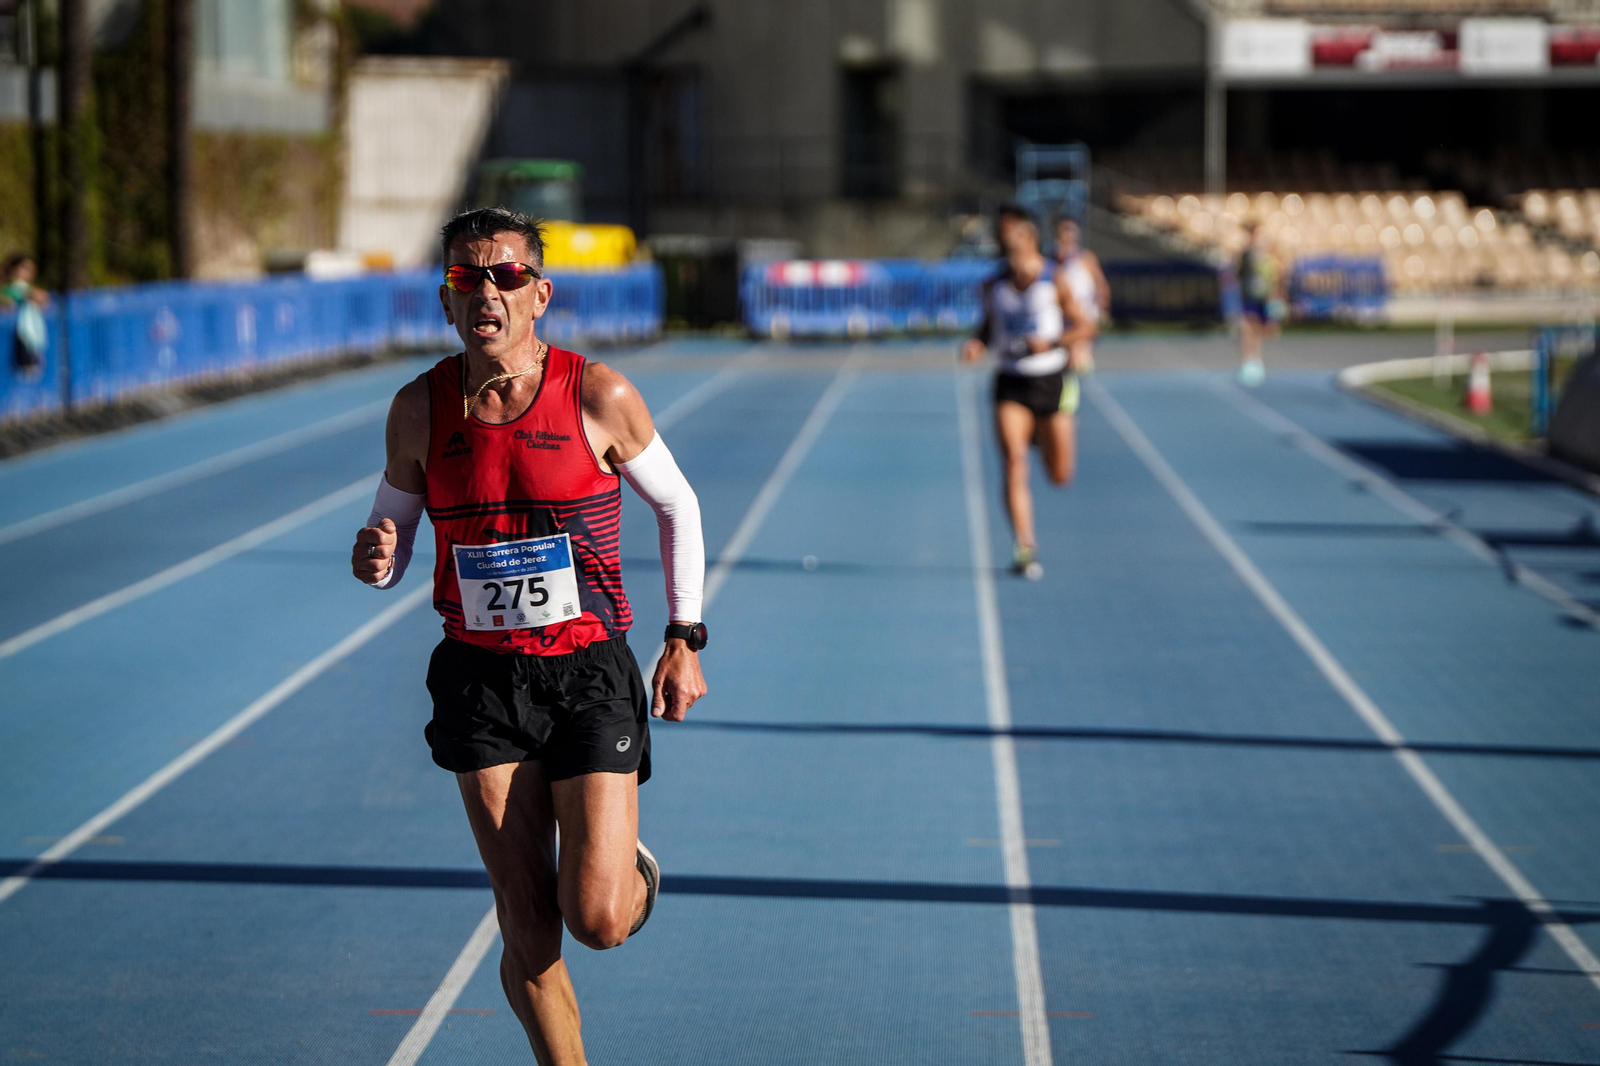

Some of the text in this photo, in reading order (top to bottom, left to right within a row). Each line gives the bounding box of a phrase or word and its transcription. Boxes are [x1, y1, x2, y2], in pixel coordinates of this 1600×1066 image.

[467, 543, 555, 559] XLIII Carrera Popular
[477, 555, 547, 569] Ciudad de Jerez
[483, 577, 549, 610] 275
